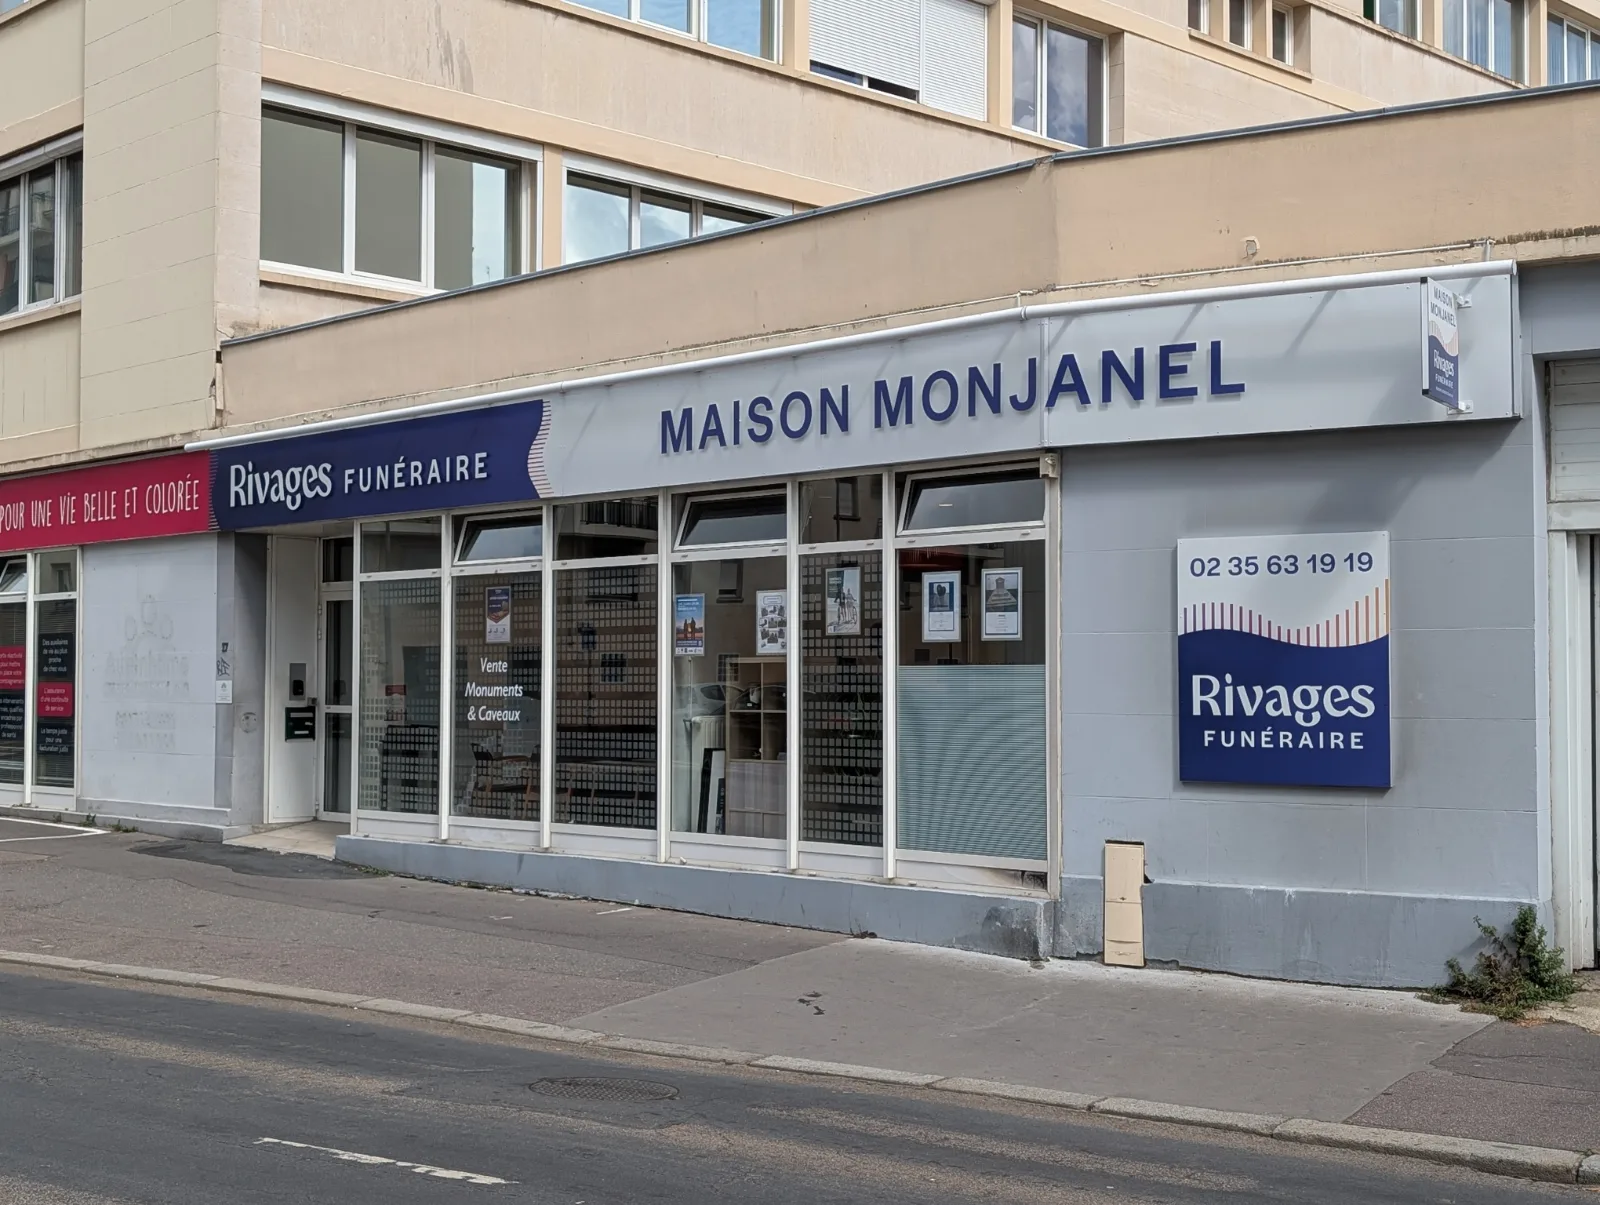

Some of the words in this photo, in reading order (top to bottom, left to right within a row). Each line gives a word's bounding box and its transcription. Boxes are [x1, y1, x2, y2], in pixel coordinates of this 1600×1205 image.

[1434, 286, 1452, 308] MAISON
[1430, 301, 1456, 327] MONJANEL
[1434, 349, 1454, 378] Rivages
[660, 384, 850, 454] MAISON
[874, 340, 1246, 430] MONJANEL
[229, 461, 332, 511] Rivages
[344, 452, 488, 494] FUNÉRAIRE
[0, 500, 25, 533] POUR
[32, 500, 52, 527] UNE
[84, 490, 116, 523] BELLE
[124, 486, 138, 518] ET
[146, 474, 200, 514] COLORÉE
[1190, 557, 1220, 578] 02
[1228, 556, 1260, 576] 35
[1266, 554, 1299, 575] 63
[1306, 552, 1336, 574] 19
[1344, 551, 1374, 573] 19
[480, 657, 508, 672] Vente
[465, 682, 523, 697] Monuments
[1192, 672, 1376, 727] Rivages
[467, 706, 476, 721] &
[478, 706, 521, 721] Caveaux
[1204, 726, 1364, 750] FUNÉRAIRE
